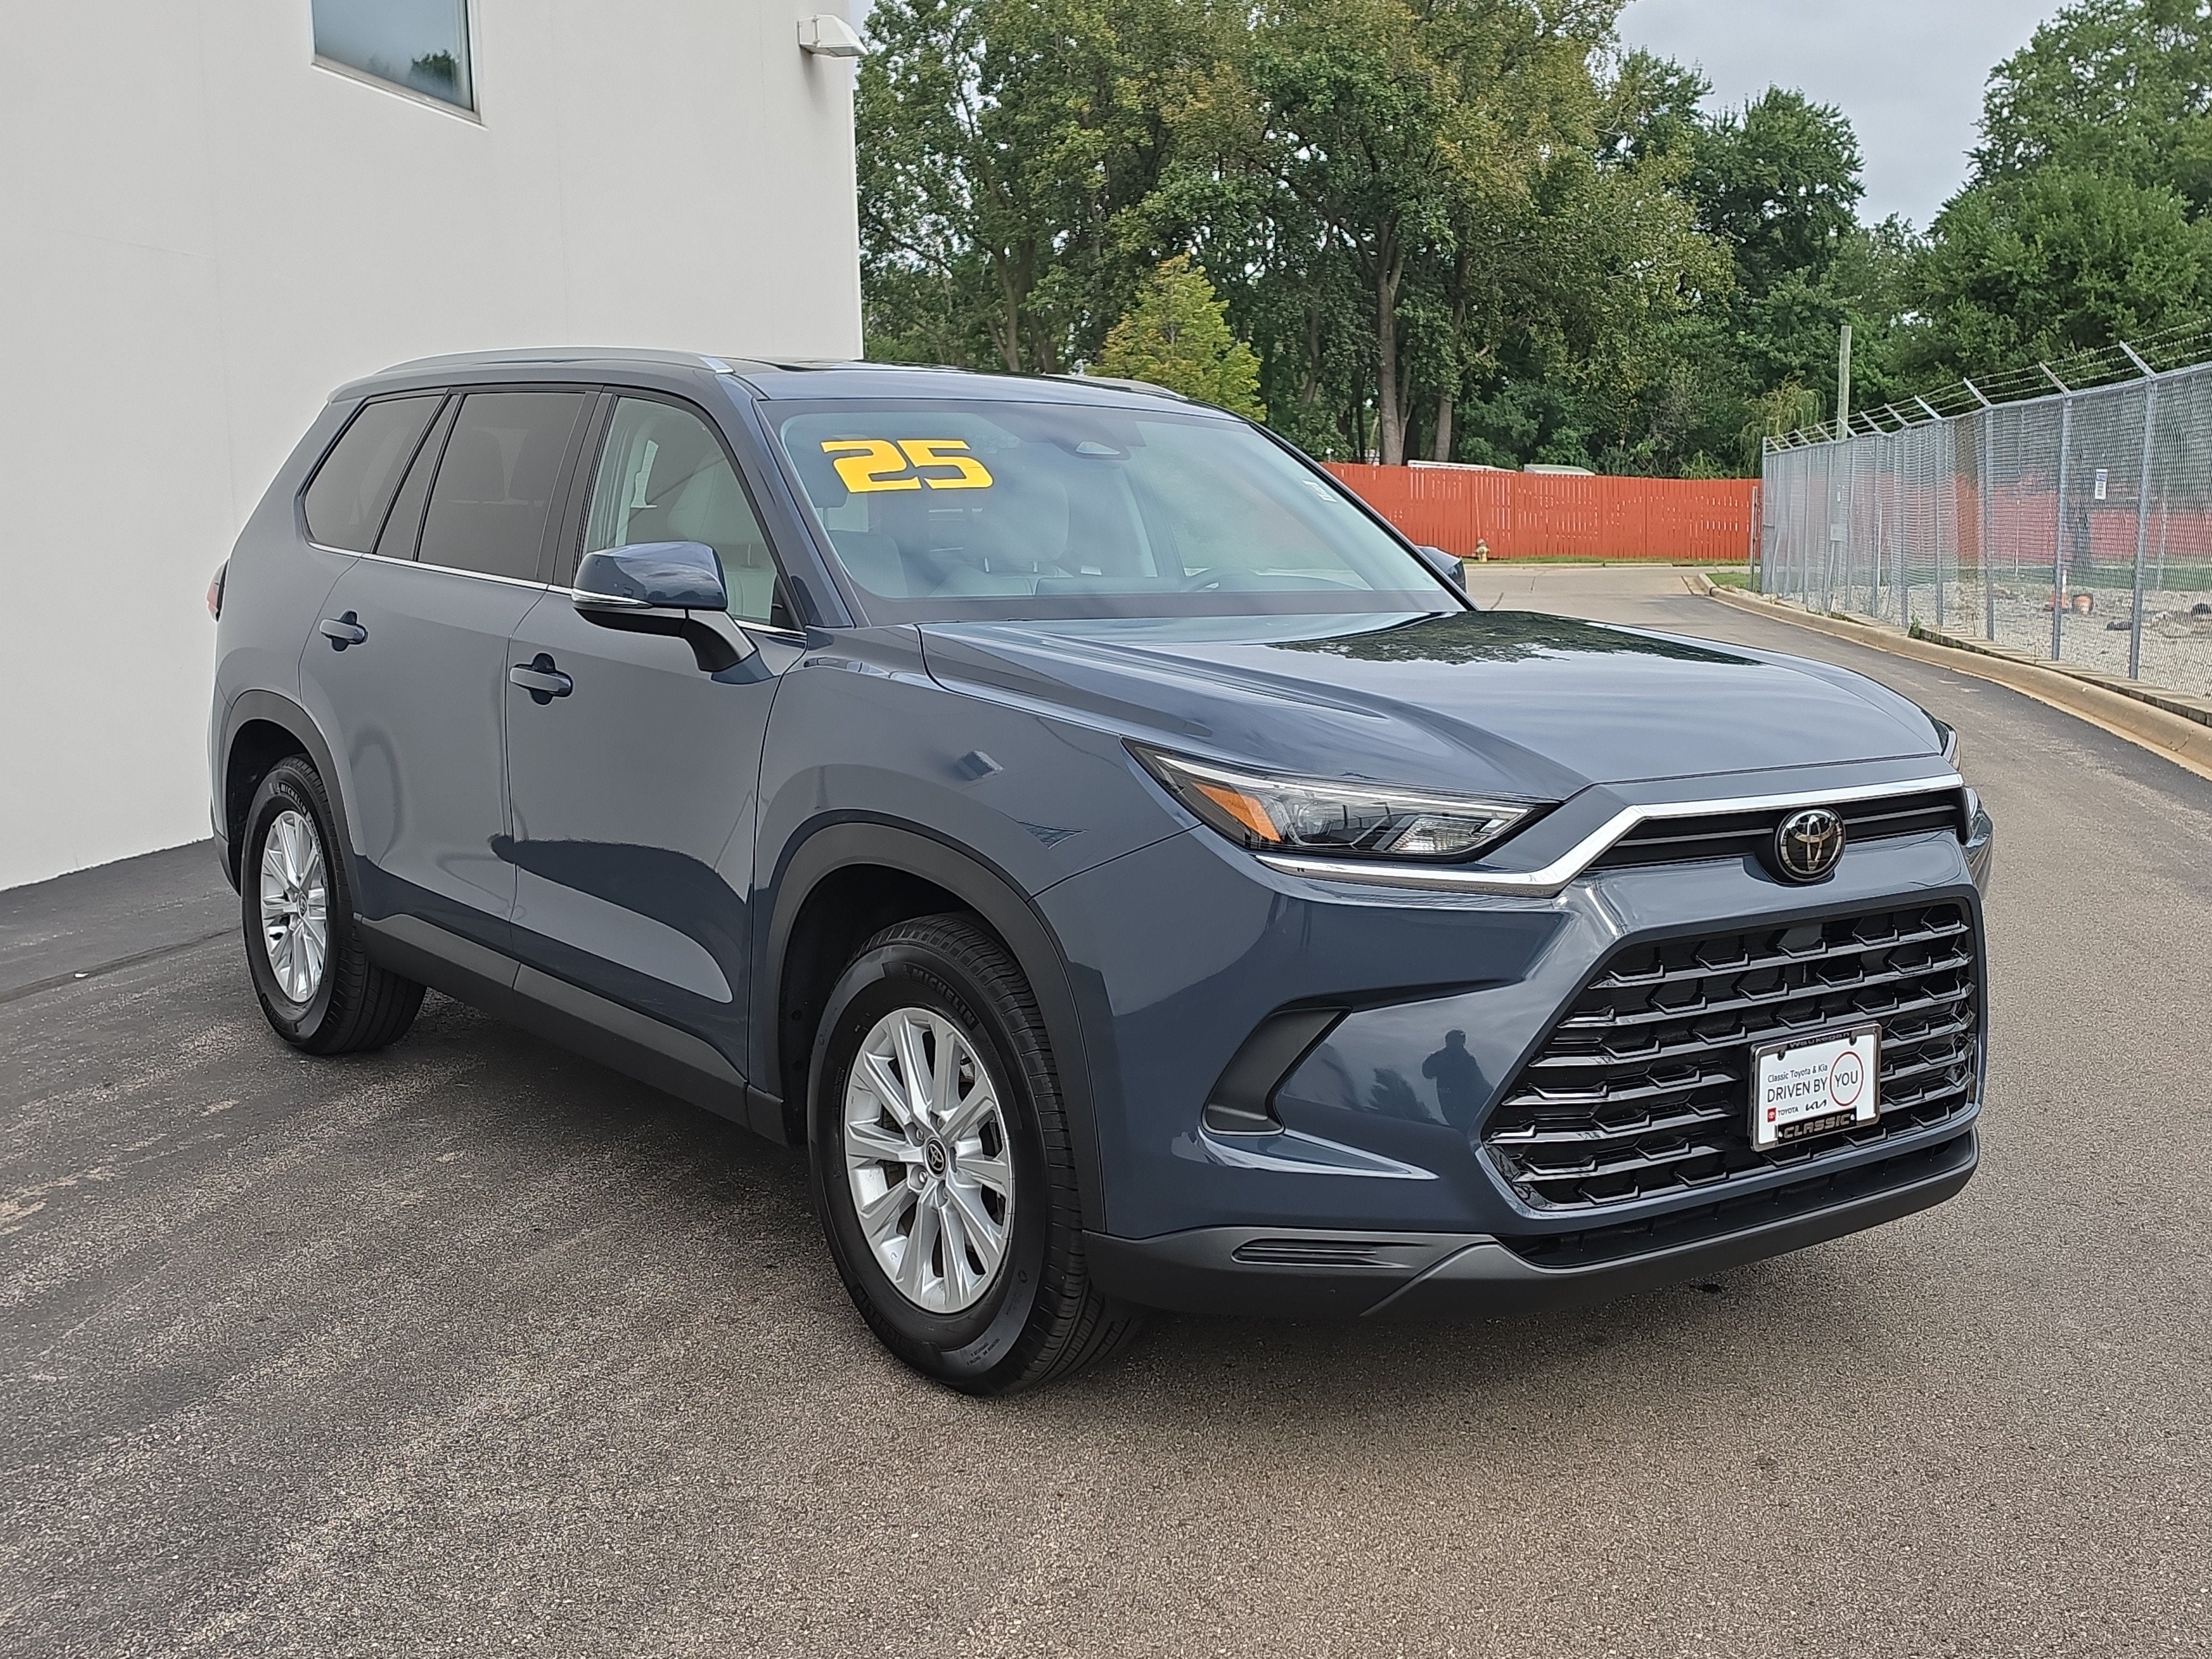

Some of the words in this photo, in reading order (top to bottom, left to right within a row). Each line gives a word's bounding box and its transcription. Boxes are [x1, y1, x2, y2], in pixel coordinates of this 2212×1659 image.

[820, 439, 994, 493] 25
[911, 968, 976, 1027] MICHELIN
[1767, 1081, 1810, 1103] DRIVEN
[1814, 1077, 1828, 1092] BY
[1835, 1070, 1858, 1087] YOU
[1768, 1072, 1789, 1082] Classic
[1790, 1069, 1810, 1078] Toyota
[1778, 1107, 1799, 1116] TOYOTA
[1784, 1114, 1850, 1139] CLASSIC
